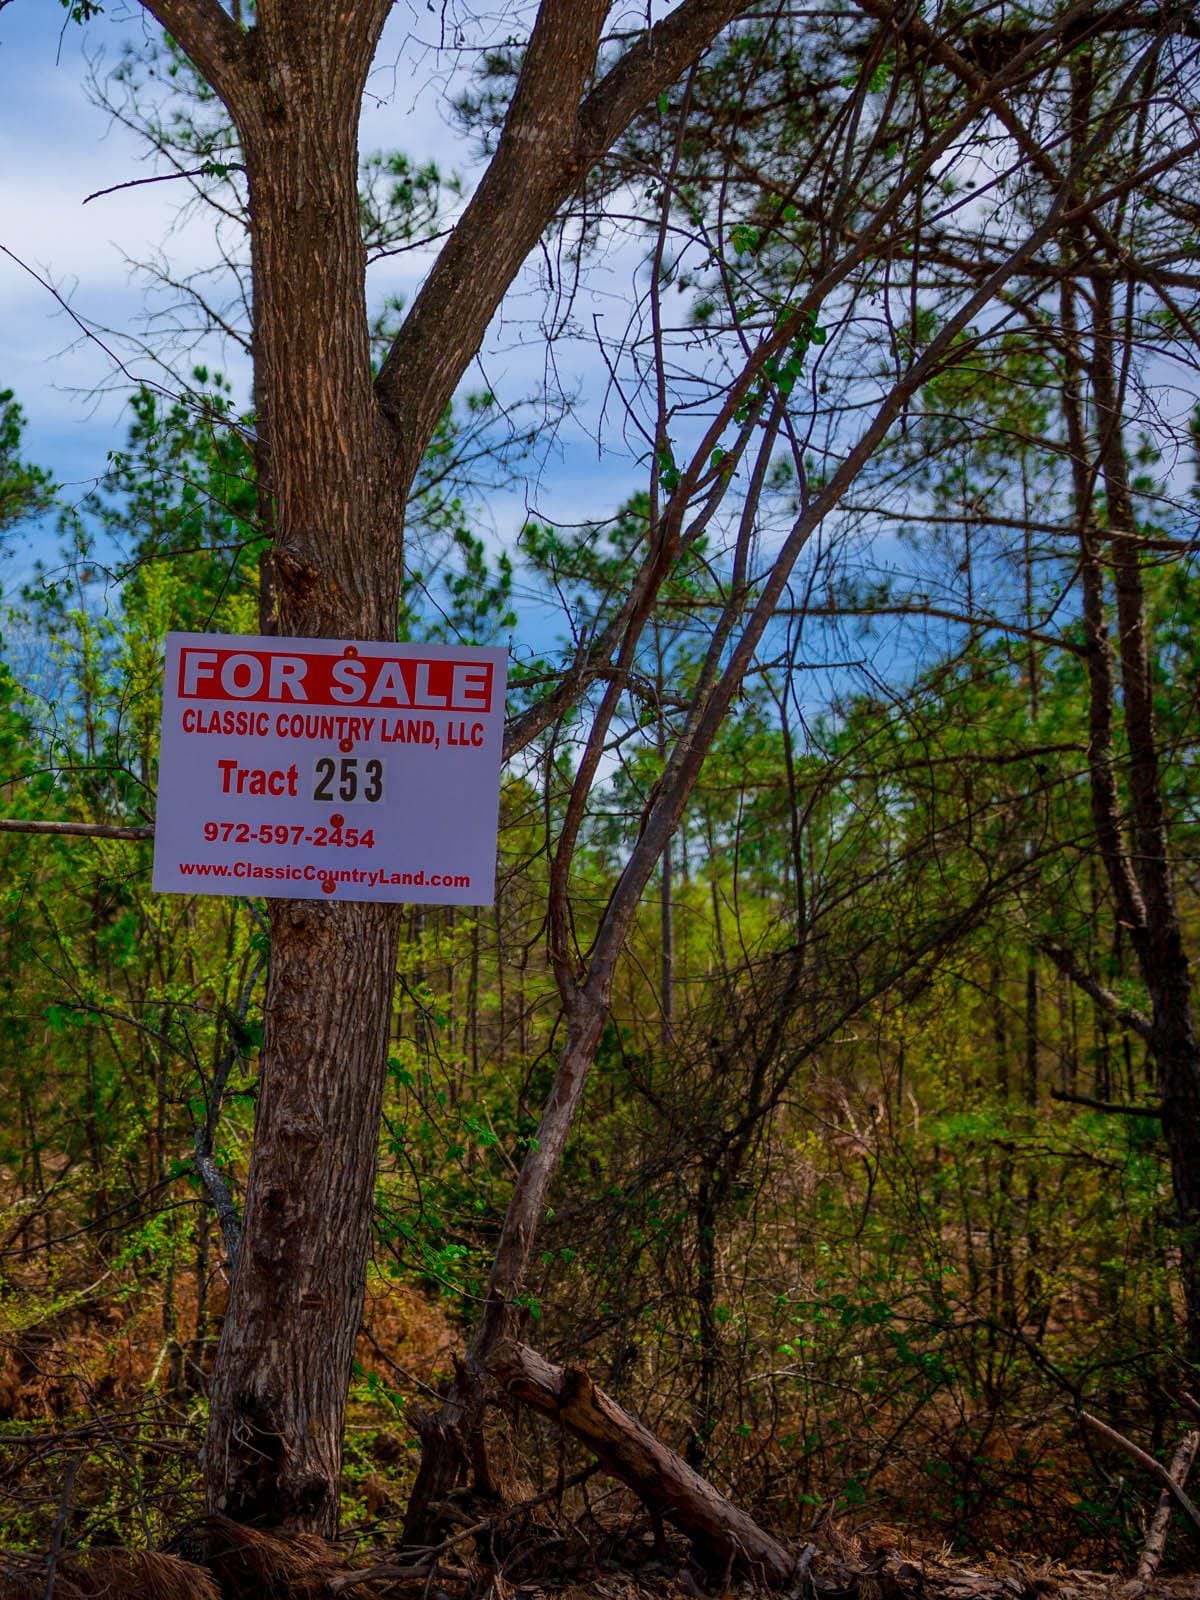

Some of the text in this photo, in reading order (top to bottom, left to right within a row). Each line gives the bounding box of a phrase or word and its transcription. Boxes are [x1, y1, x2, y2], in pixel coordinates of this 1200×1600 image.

[183, 651, 488, 709] FOR SALE
[182, 709, 484, 750] CLASSIC COUNTRY LAND, LLC
[218, 758, 384, 802] Tract 253
[203, 822, 375, 849] 972-597-2454
[179, 862, 470, 888] www.ClassicCountryLand.com
